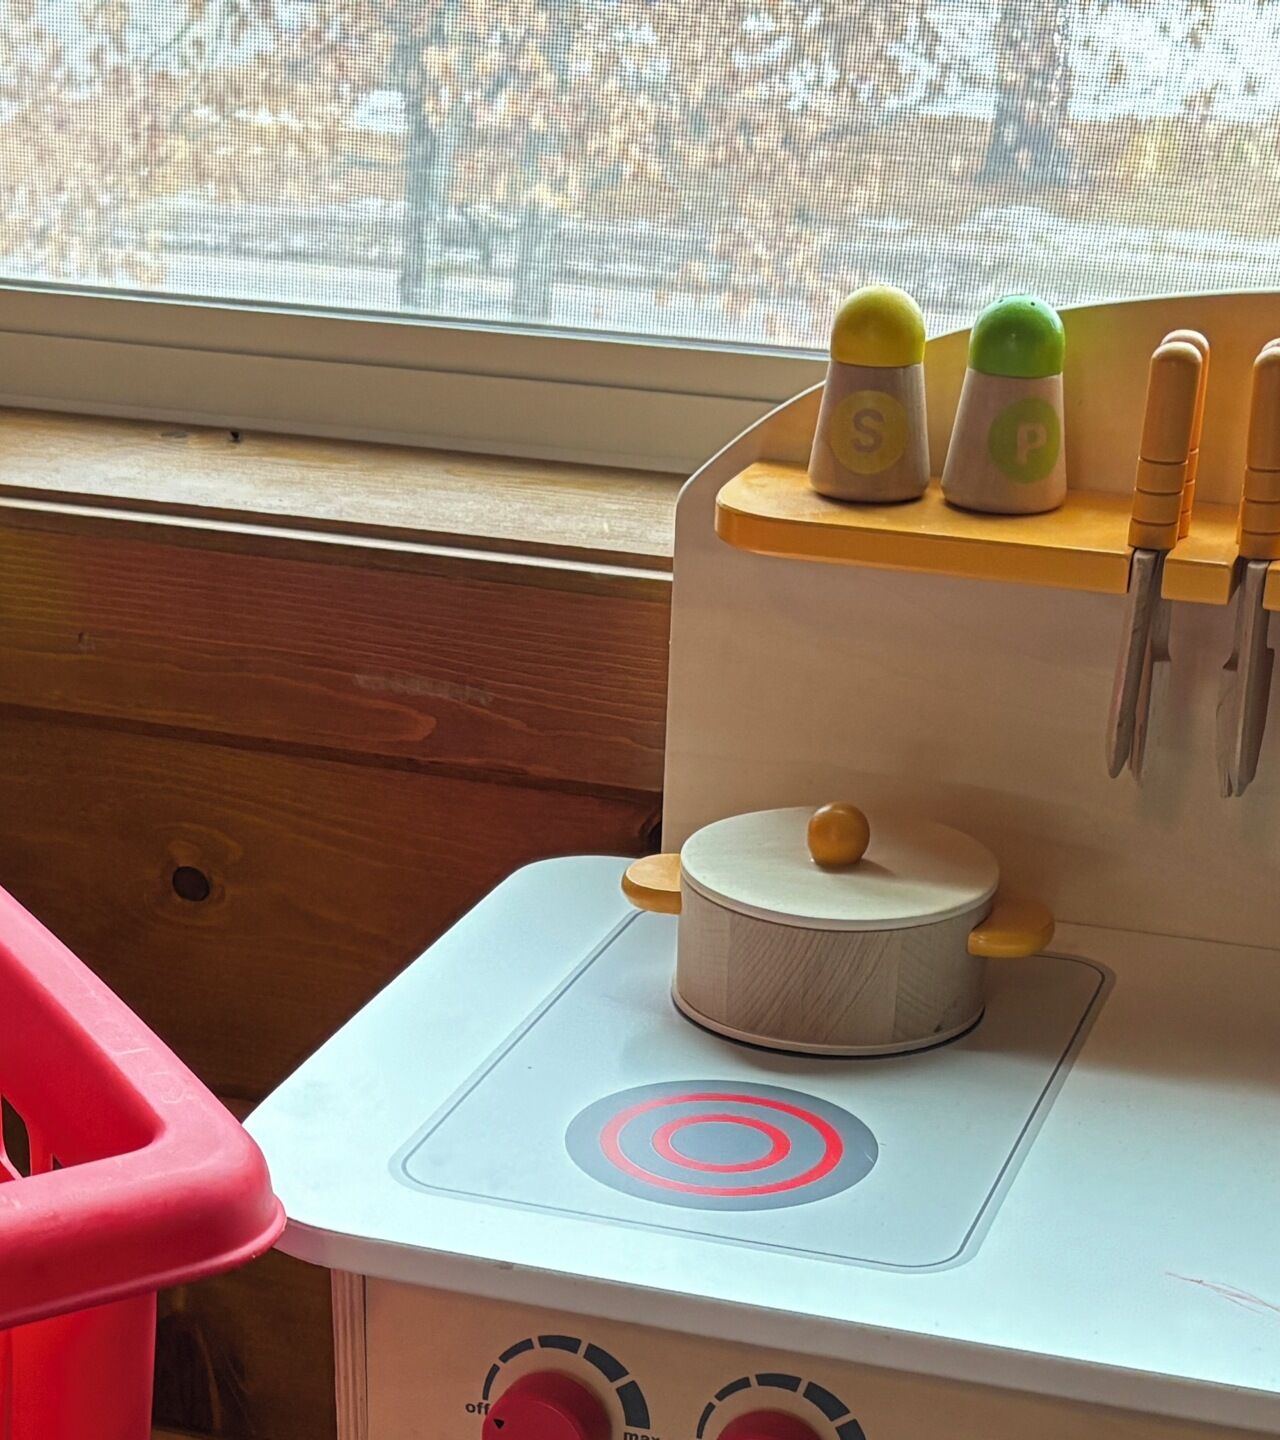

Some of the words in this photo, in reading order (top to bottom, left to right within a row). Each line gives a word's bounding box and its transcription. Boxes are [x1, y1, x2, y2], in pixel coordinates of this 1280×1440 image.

[852, 407, 885, 454] S
[1017, 421, 1047, 466] P
[465, 1402, 491, 1416] off
